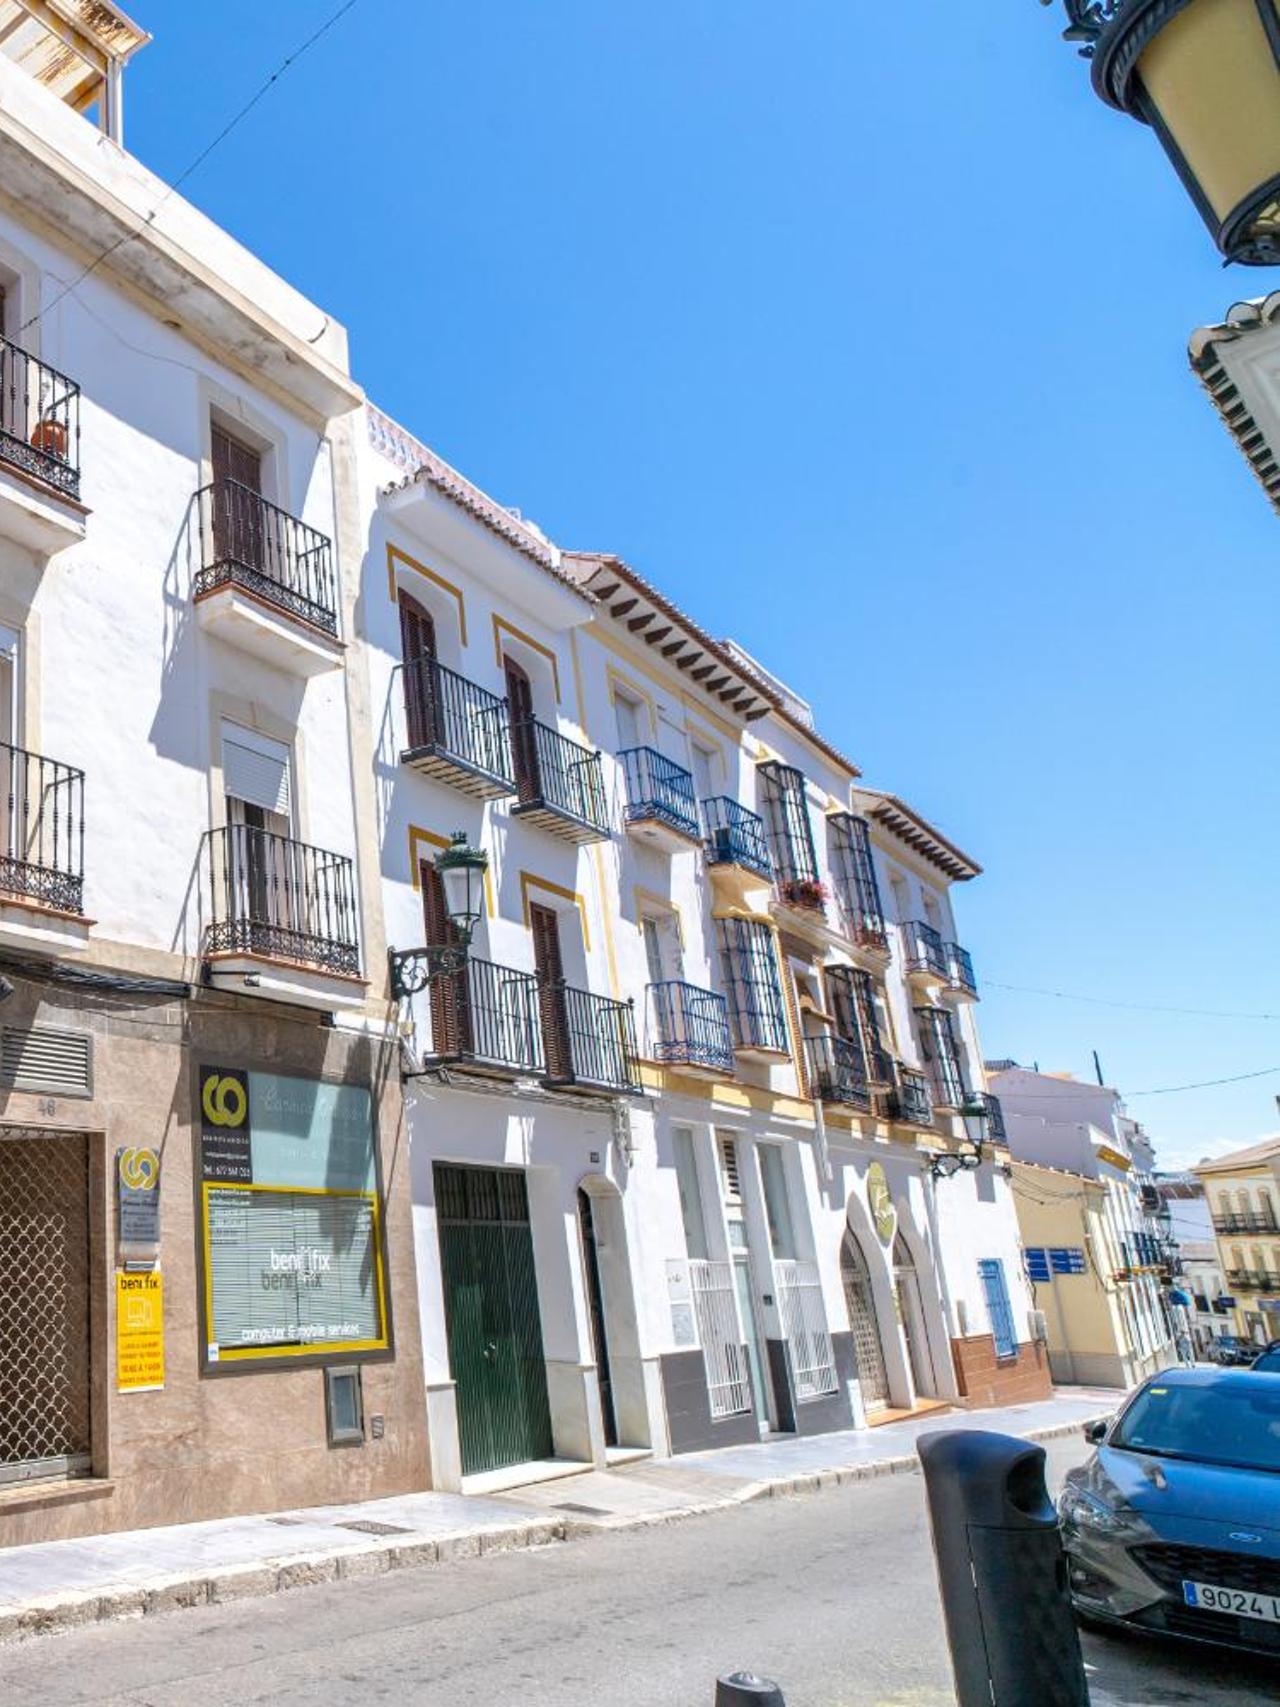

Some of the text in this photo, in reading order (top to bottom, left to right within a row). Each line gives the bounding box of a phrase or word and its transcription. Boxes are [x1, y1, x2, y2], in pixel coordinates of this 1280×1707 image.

[37, 1098, 56, 1117] 48
[270, 1247, 331, 1271] beni fix
[120, 1275, 159, 1291] beni fix
[1201, 1587, 1263, 1616] 9024
